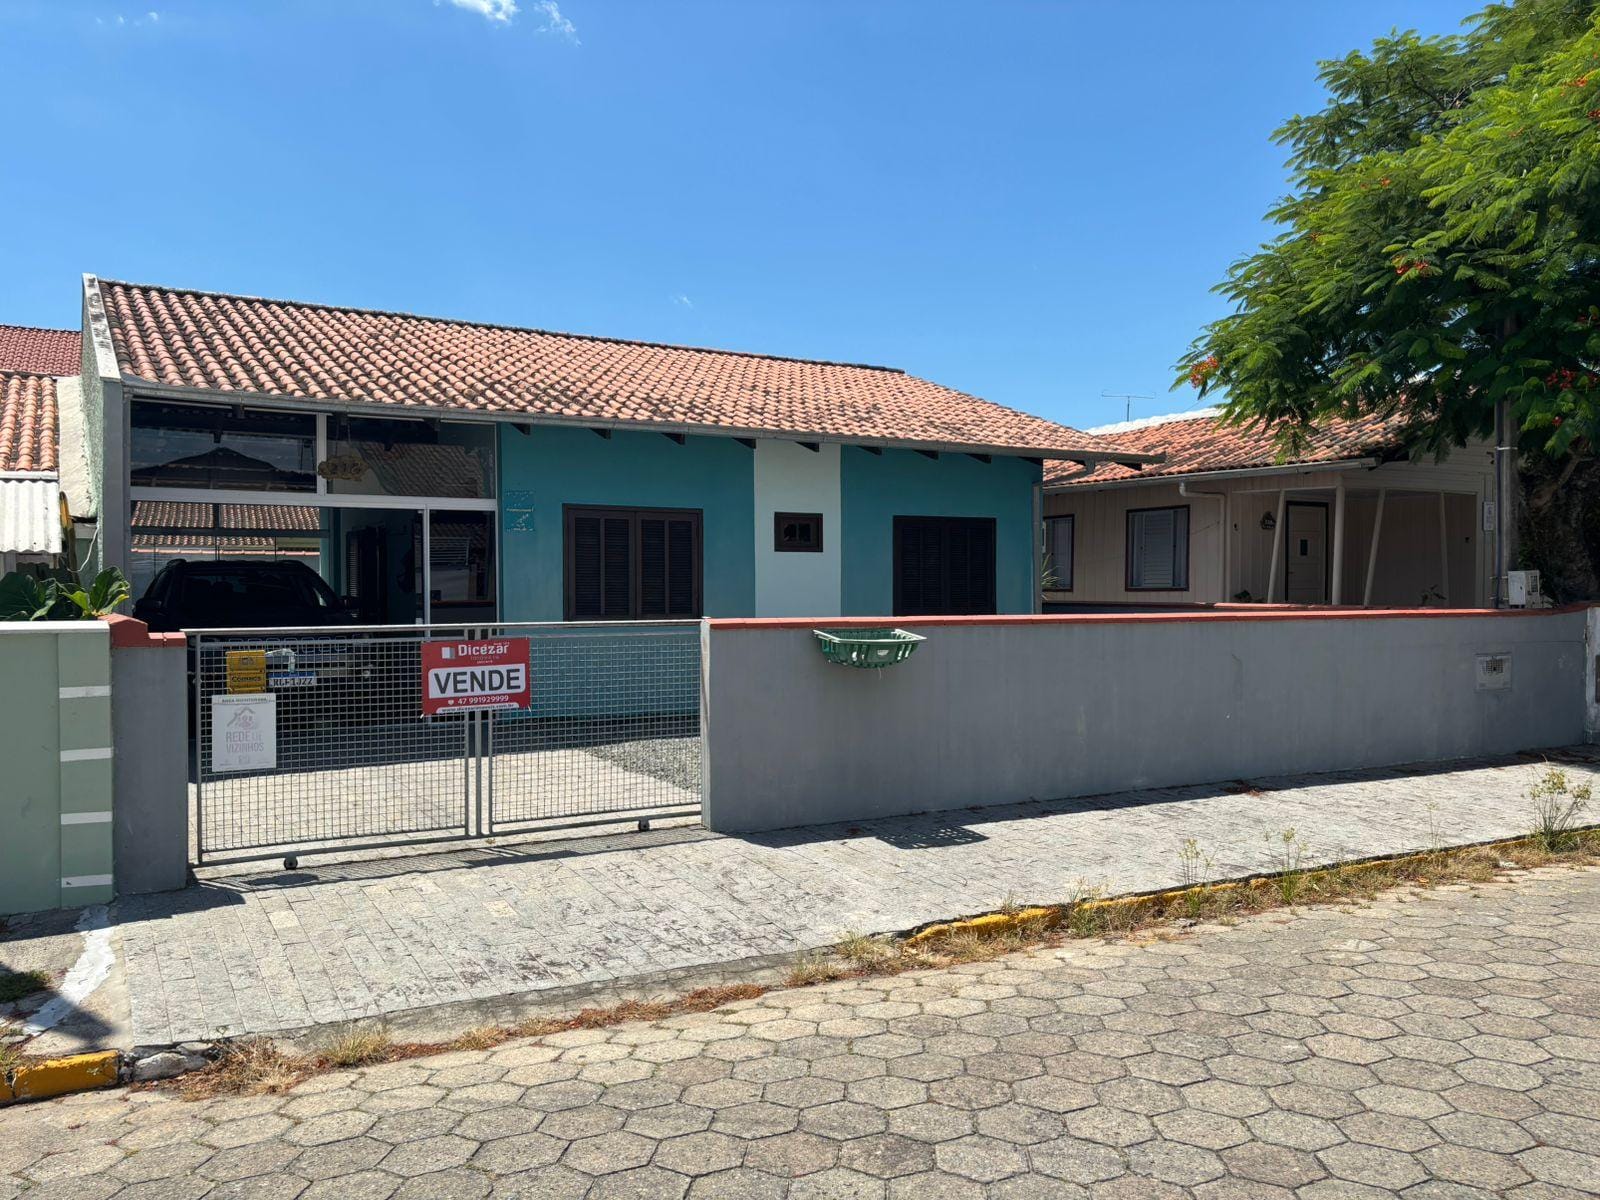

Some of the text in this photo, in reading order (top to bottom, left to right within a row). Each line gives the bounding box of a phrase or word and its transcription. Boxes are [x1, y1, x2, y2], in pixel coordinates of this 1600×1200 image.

[457, 643, 509, 656] Dicézar
[434, 669, 521, 694] VENDE
[469, 695, 509, 704] 991929999
[225, 731, 250, 742] REDE
[226, 742, 265, 753] VIZINHOS
